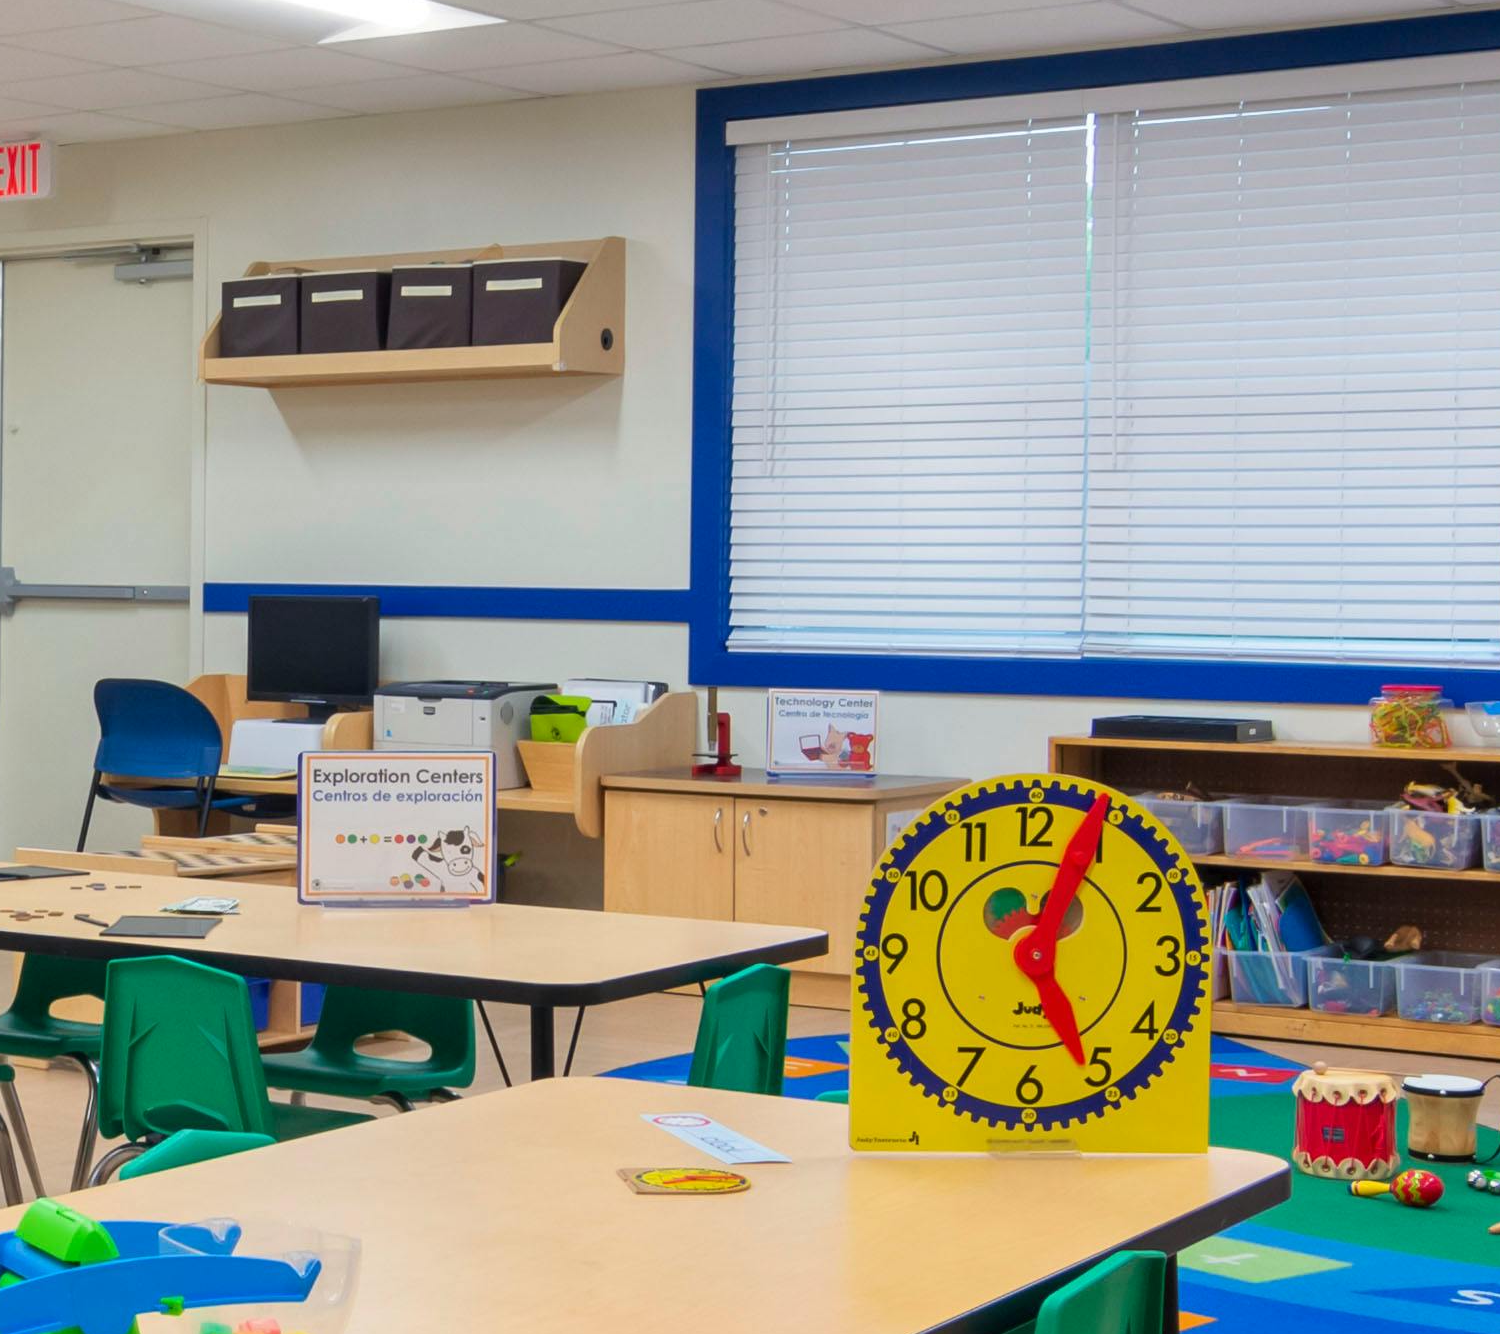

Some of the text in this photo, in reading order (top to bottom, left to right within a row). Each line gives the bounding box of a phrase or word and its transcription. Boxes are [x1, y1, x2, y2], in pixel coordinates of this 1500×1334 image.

[775, 696, 873, 709] Technology Center
[778, 709, 808, 718] Centro
[809, 710, 821, 718] de
[313, 768, 484, 786] Exploration Centers
[313, 788, 483, 805] Centros de exploración
[1030, 791, 1043, 801] 60
[960, 822, 987, 862] 11
[1015, 807, 1054, 847] 12
[905, 869, 949, 912] 10
[1136, 871, 1162, 913] 2
[1168, 871, 1180, 880] 10
[881, 933, 909, 975] 9
[1155, 935, 1181, 977] 3
[1188, 953, 1199, 962] 15
[901, 998, 927, 1040] 8
[1012, 1001, 1047, 1019] Jud
[1131, 1000, 1159, 1041] 4
[887, 1030, 899, 1039] 40
[1165, 1032, 1177, 1041] 20
[957, 1046, 987, 1088] 7
[1016, 1064, 1044, 1105] 6
[1084, 1046, 1112, 1087] 5
